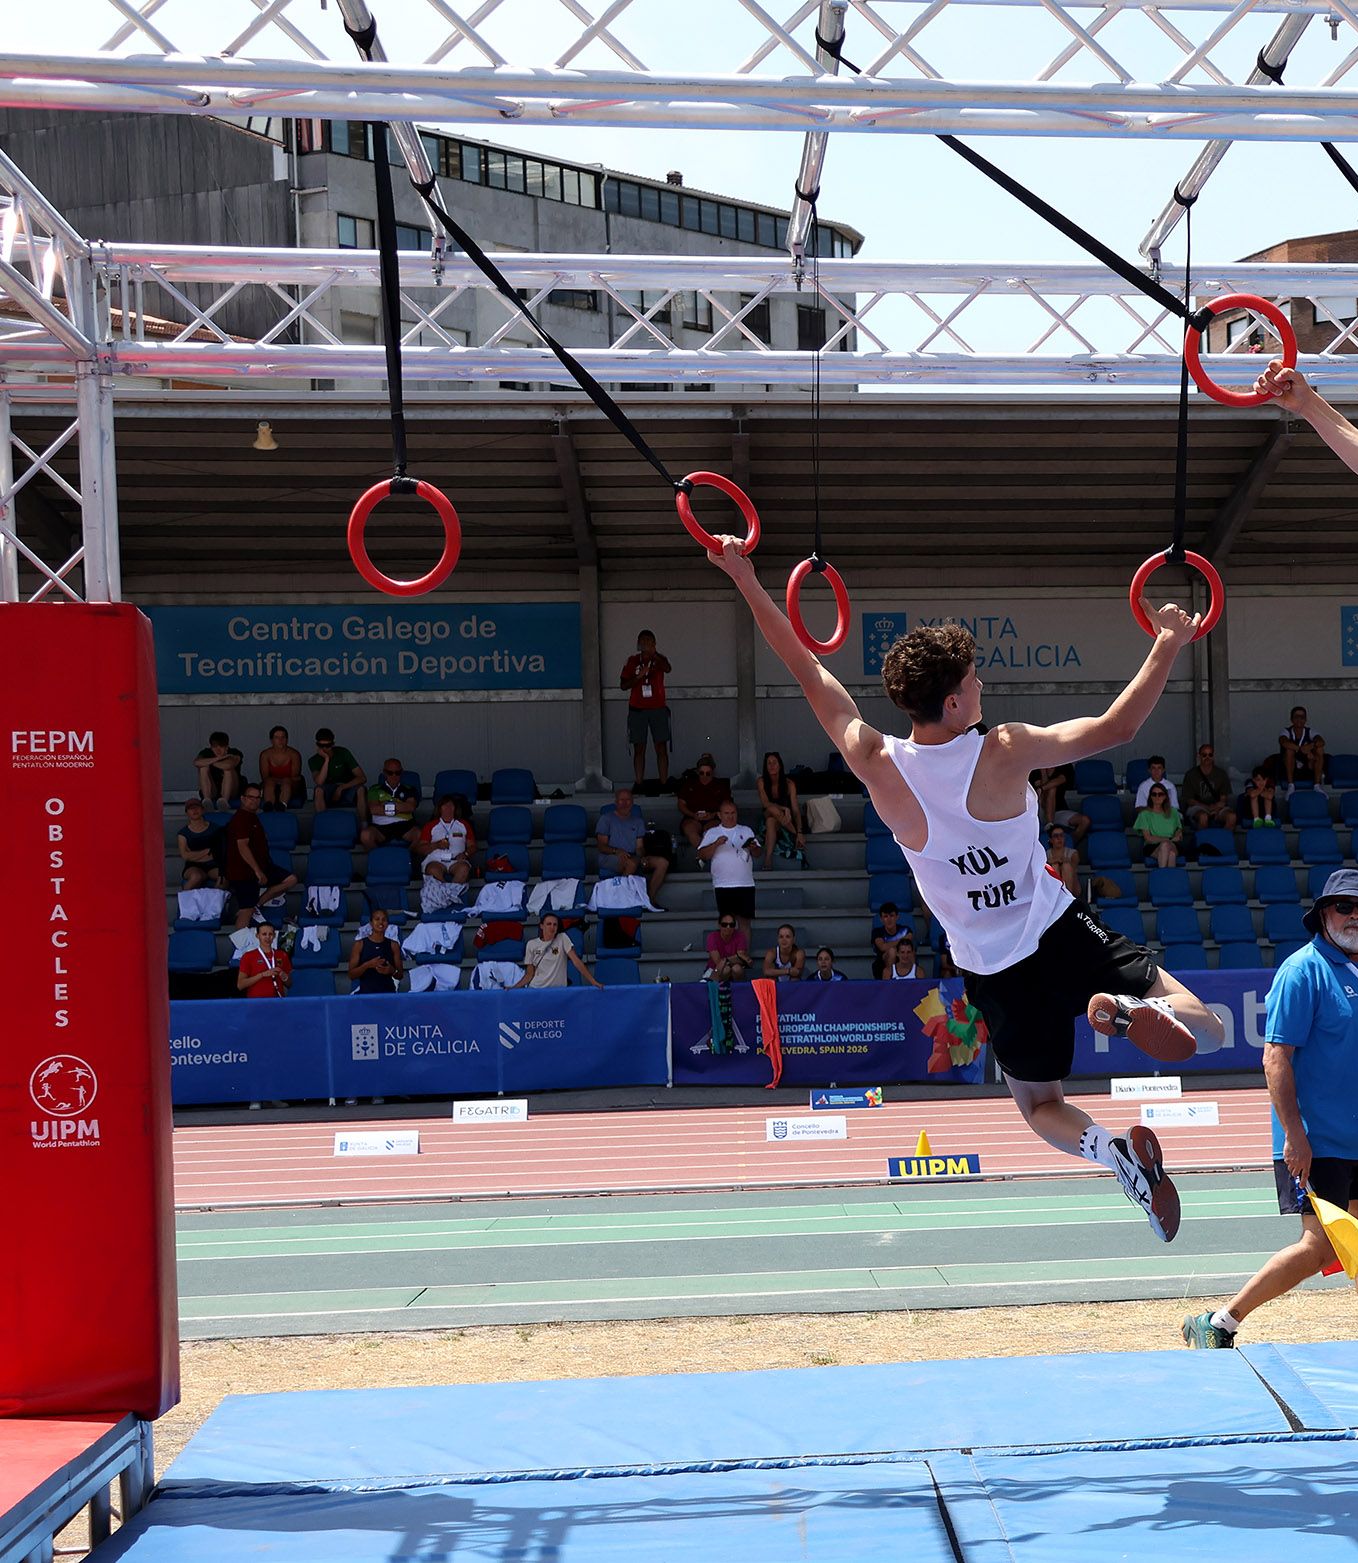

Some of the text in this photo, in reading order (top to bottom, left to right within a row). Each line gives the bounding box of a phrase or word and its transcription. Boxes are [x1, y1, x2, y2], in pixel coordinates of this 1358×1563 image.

[227, 615, 497, 645] Centro Galego de
[178, 650, 545, 680] Tecnificación Deportiva
[12, 731, 94, 752] FEPM
[967, 880, 1017, 911] TÜR
[45, 798, 69, 1027] OBSTACLES
[1083, 915, 1110, 944] TERREX
[384, 1025, 443, 1039] XUNTA
[524, 1020, 565, 1029] DEPORTE
[823, 1022, 897, 1032] CHAMPIONSHIPS
[898, 1022, 905, 1031] &
[169, 1036, 201, 1049] ello
[525, 1031, 562, 1040] GALEGO
[839, 1033, 873, 1043] WORLD
[874, 1032, 906, 1042] SERIES
[384, 1040, 480, 1056] DE GALICIA
[819, 1045, 845, 1054] SPAIN
[846, 1045, 868, 1053] 2026
[171, 1051, 248, 1065] ontevedra
[31, 1120, 100, 1141] UIPM
[58, 1139, 100, 1147] Pentathlon
[899, 1157, 970, 1175] UIPM
